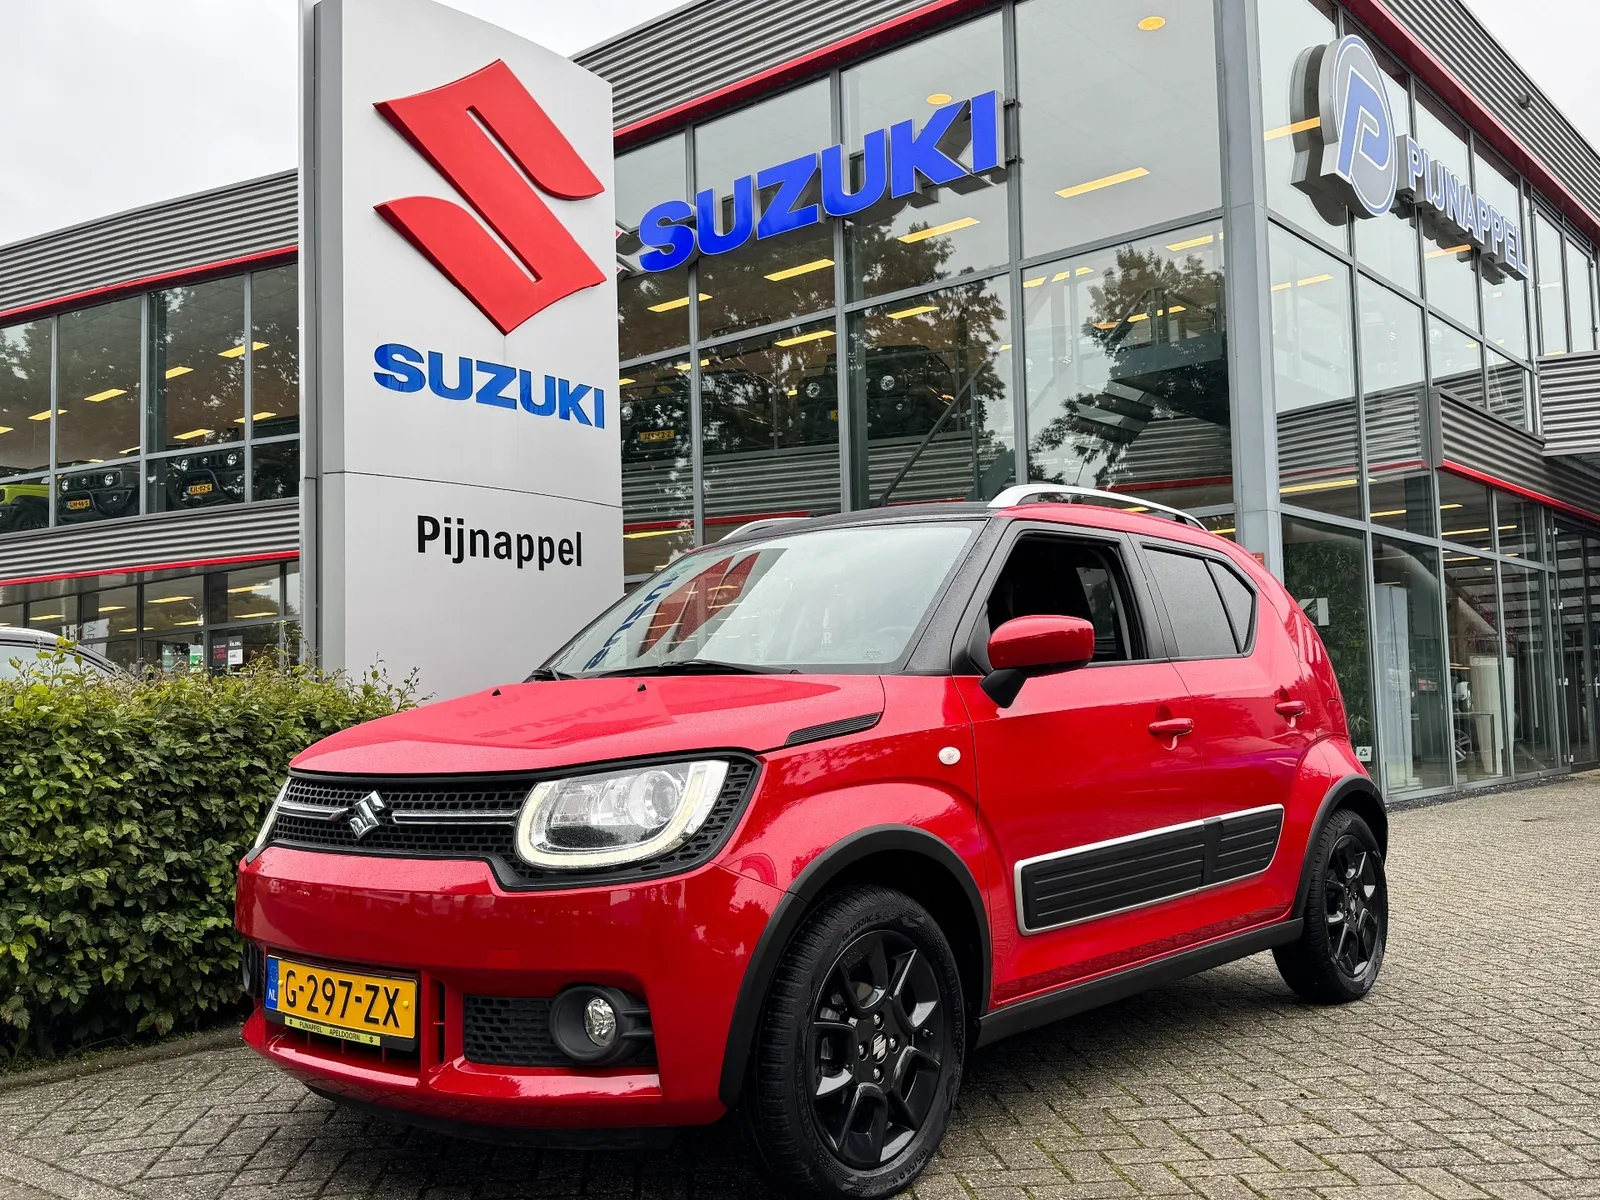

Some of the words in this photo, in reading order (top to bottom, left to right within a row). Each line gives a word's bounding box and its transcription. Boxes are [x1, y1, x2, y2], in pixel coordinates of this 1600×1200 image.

[638, 89, 1003, 272] SUZUKI
[1405, 134, 1529, 280] PIJNAPPEL
[373, 343, 605, 429] SUZUKI
[417, 515, 582, 571] Pijnappel
[267, 988, 277, 1001] NL
[285, 969, 400, 1028] G-297-ZX
[299, 1021, 323, 1034] PIJNAPPEL
[329, 1028, 361, 1041] APELDOORN
